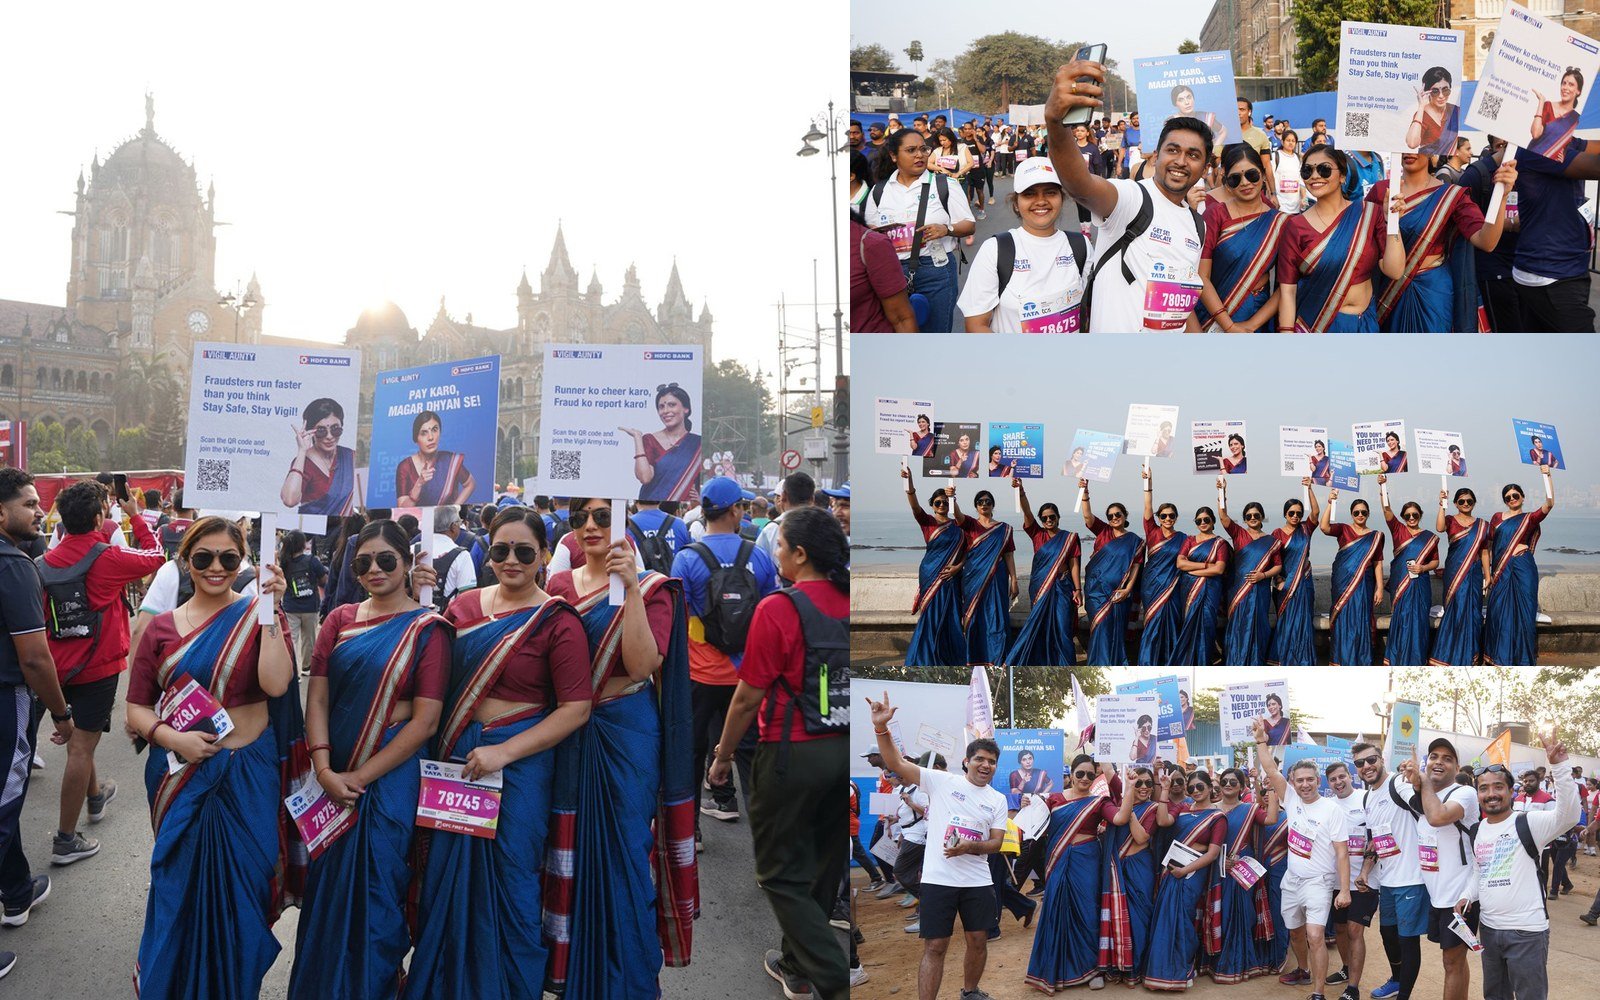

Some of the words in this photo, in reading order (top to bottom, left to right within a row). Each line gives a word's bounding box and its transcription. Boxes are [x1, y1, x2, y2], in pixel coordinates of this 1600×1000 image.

[1350, 48, 1386, 57] Fraudsters
[1502, 39, 1522, 54] Runner
[1523, 49, 1530, 58] ko
[1531, 53, 1548, 66] cheer
[1499, 49, 1515, 62] Fraud
[1516, 57, 1523, 66] ko
[1524, 61, 1541, 75] report
[1180, 68, 1204, 76] KARO,
[1349, 69, 1363, 77] Stay
[1366, 70, 1382, 78] Safe,
[1385, 71, 1399, 80] Stay
[1402, 72, 1418, 81] Vigil!
[1148, 79, 1177, 89] MAGAR
[1179, 76, 1206, 86] DHYAN
[1150, 232, 1171, 242] EDUCATE
[1162, 293, 1190, 307] 78050
[1040, 316, 1076, 333] 78675
[208, 351, 226, 360] VIGIL
[229, 352, 255, 361] AUNTY
[205, 376, 254, 387] Fraudsters
[275, 380, 301, 389] faster
[400, 373, 419, 382] AUNTY
[204, 389, 224, 398] than
[227, 391, 243, 400] you
[247, 391, 270, 401] think
[409, 389, 428, 400] PAY
[430, 384, 459, 397] KARO,
[555, 386, 585, 395] Runner
[588, 387, 599, 395] ko
[602, 387, 627, 396] cheer
[629, 388, 651, 397] karo,
[203, 402, 222, 413] Stay
[226, 403, 249, 414] Safe,
[252, 404, 271, 416] Stay
[275, 406, 298, 417] Vigil!
[388, 402, 422, 417] MAGAR
[426, 398, 461, 412] DHYAN
[464, 395, 481, 408] SE!
[554, 398, 578, 407] Fraud
[582, 399, 592, 407] ko
[595, 399, 621, 409] report
[624, 400, 647, 408] karo!
[223, 446, 235, 454] Vigil
[237, 447, 252, 455] Army
[1003, 448, 1036, 456] FEELINGS
[1232, 702, 1249, 711] NEED
[214, 713, 225, 724] TAT
[1232, 712, 1241, 720] TO
[438, 790, 480, 811] 78745
[293, 803, 308, 814] TATA
[312, 801, 336, 830] 7875
[1236, 862, 1251, 879] 78751
